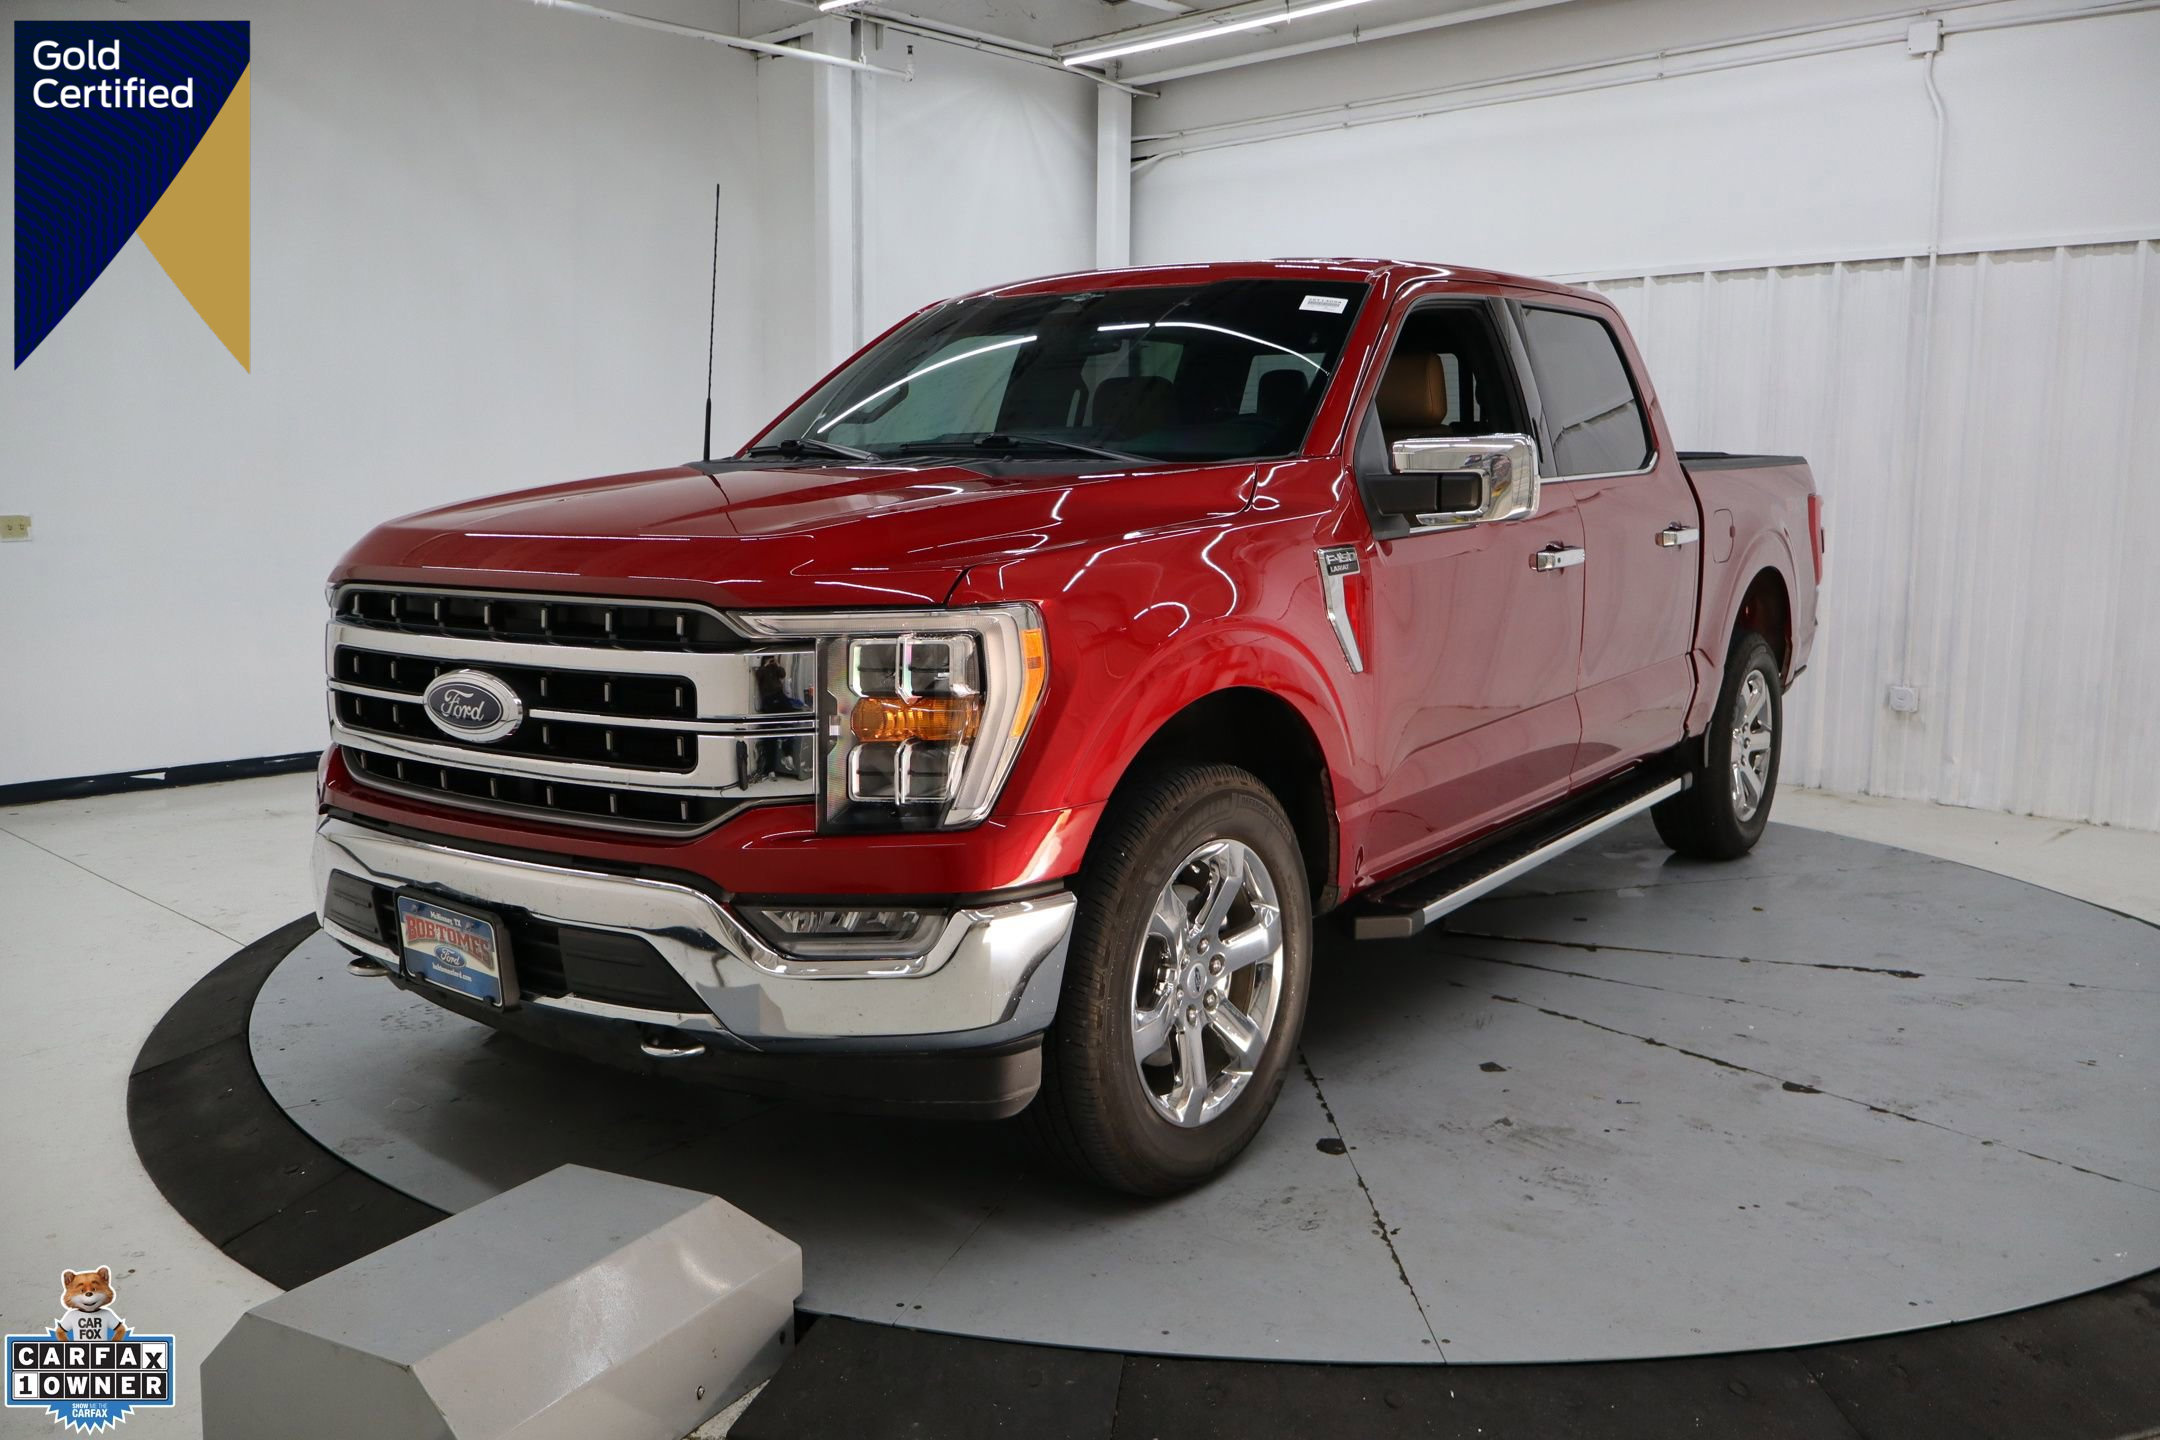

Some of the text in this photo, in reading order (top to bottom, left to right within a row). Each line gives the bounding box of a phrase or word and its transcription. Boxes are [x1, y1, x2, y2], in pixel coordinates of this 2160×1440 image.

[440, 688, 486, 721] Ford
[405, 914, 437, 942] BOB
[440, 947, 461, 967] Ford
